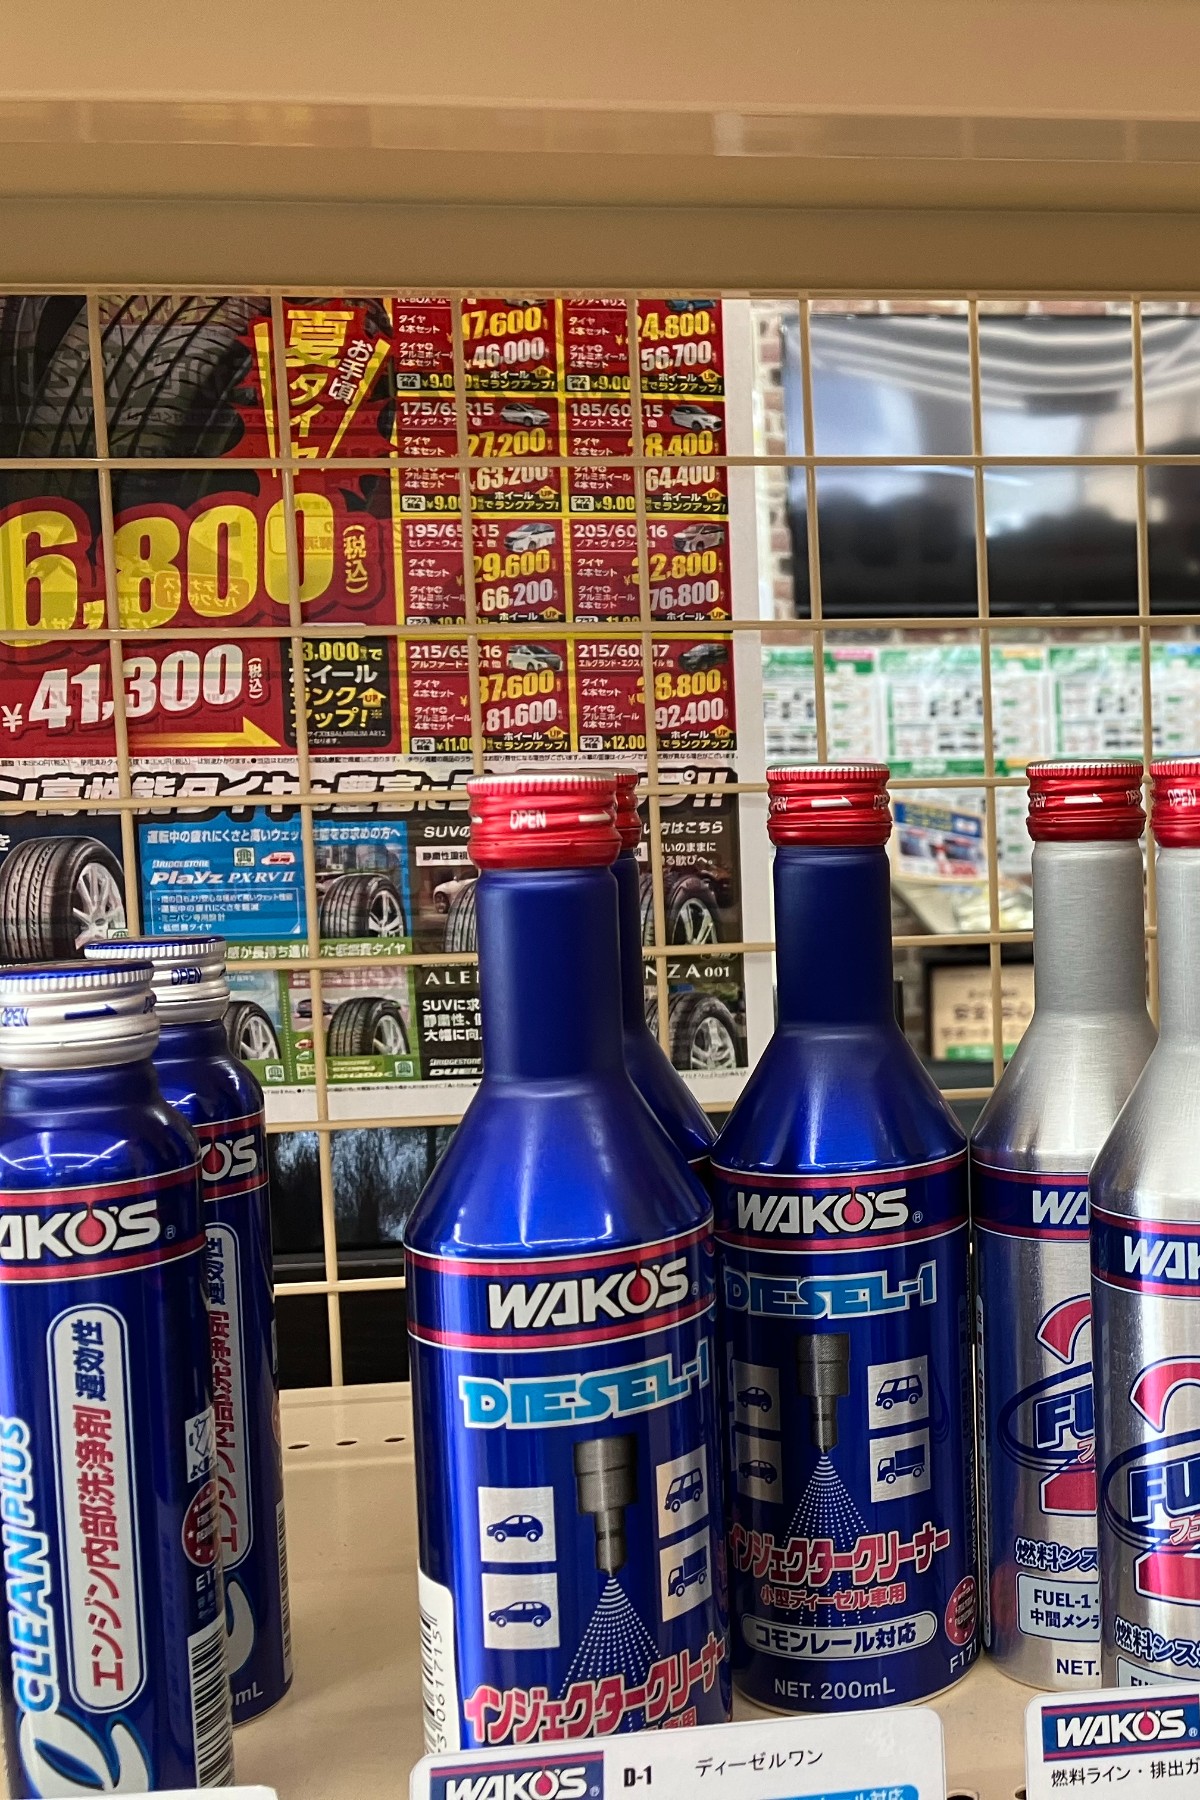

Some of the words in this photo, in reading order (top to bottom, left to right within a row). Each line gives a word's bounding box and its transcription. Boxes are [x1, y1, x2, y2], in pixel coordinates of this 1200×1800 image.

[490, 370, 530, 379] ホイール
[658, 373, 697, 382] ホイール
[570, 403, 664, 417] 185/6015
[494, 491, 534, 500] ホイール
[662, 493, 701, 502] ホイール
[574, 524, 668, 538] 205/6016
[661, 739, 734, 750] でランクアップ!
[1168, 789, 1197, 807] OPEN
[509, 809, 547, 830] OPEN
[150, 871, 224, 885] Playz
[171, 966, 203, 985] OPEN
[1, 1007, 29, 1027] OPEN
[737, 1187, 909, 1234] WAKO'S
[489, 1257, 688, 1329] WAKO'S
[722, 1259, 938, 1320] DIESEL-1
[458, 1337, 710, 1430] DIESEL-1
[72, 1404, 124, 1691] エンジン内部洗浄剤
[729, 1521, 950, 1588] インジェクタークリーナー
[760, 1581, 906, 1612] 小型ディーゼル車用
[755, 1621, 917, 1655] コモンレール対応
[1056, 1659, 1099, 1676] NET.
[464, 1631, 726, 1744] インジェクタークリーナー
[774, 1678, 816, 1700] NET.
[821, 1676, 896, 1701] 200mL
[1056, 1708, 1187, 1748] WAKO'S
[624, 1766, 653, 1788] D-1
[696, 1749, 824, 1779] ディーゼルワン
